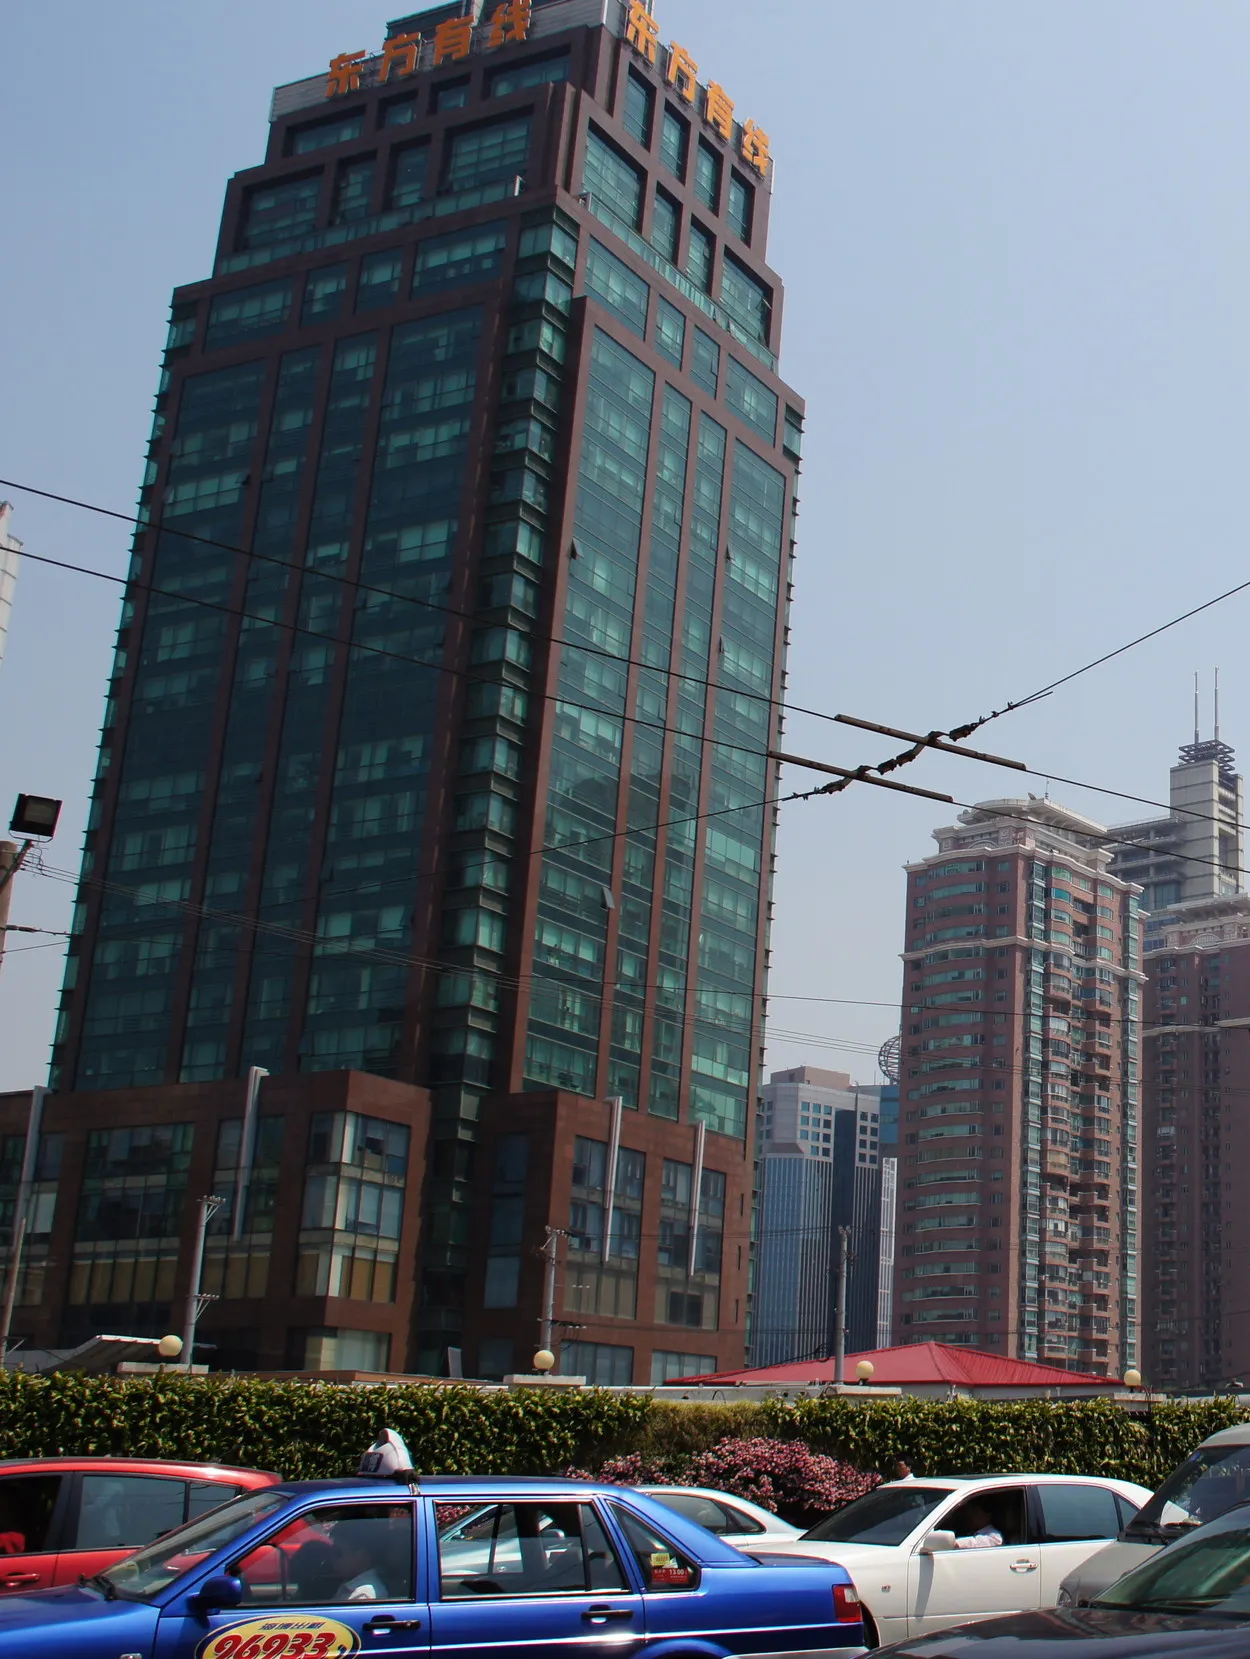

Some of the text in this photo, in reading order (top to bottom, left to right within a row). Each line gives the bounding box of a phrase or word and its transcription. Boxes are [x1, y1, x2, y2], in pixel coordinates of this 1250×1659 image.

[325, 0, 532, 97] 东方有线
[626, 0, 770, 177] 东方有线
[213, 1632, 338, 1659] 96933
